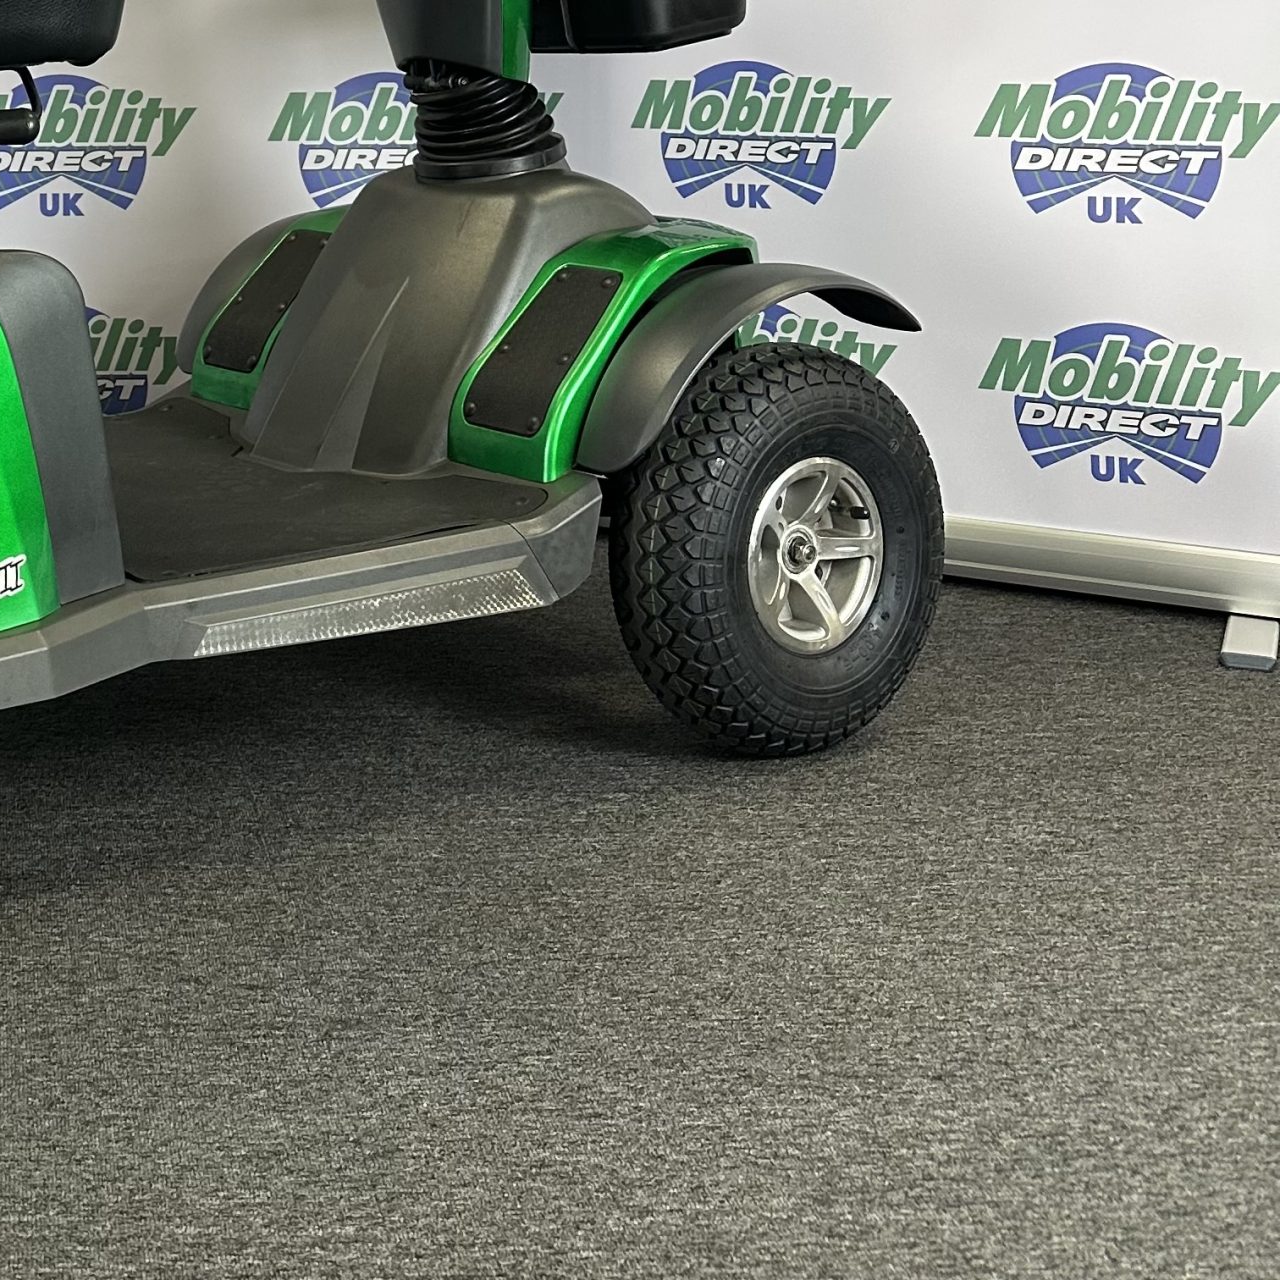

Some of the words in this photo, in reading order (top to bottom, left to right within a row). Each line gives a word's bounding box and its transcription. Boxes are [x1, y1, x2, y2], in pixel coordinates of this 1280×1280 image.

[631, 76, 892, 150] Mobility
[974, 79, 1280, 159] Mobility
[663, 139, 835, 164] DIRECT
[1013, 145, 1221, 175] DIRECT
[38, 192, 86, 218] UK
[724, 182, 772, 209] UK
[1087, 196, 1142, 225] UK
[978, 336, 1280, 427] Mobility
[1018, 402, 1220, 441] DIRECT
[1090, 454, 1146, 487] UK
